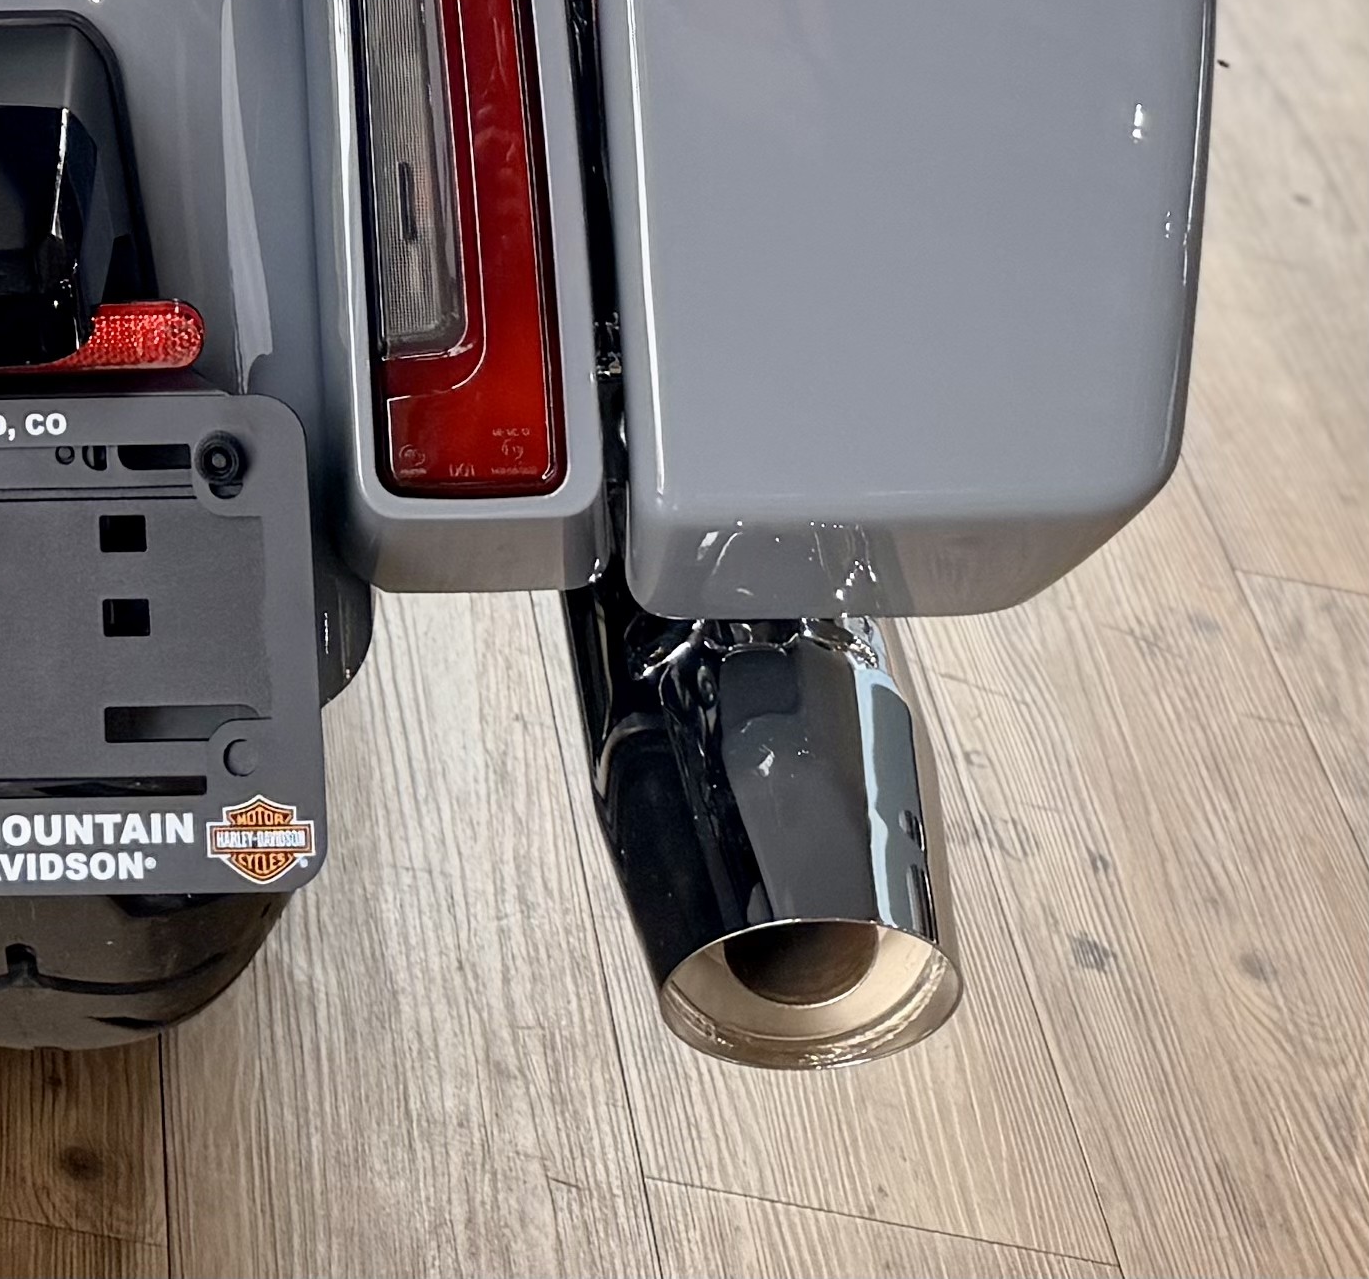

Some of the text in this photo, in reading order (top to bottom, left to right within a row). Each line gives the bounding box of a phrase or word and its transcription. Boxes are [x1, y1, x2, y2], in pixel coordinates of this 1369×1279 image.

[24, 412, 67, 436] CO
[236, 805, 284, 826] MOTOR
[237, 852, 286, 875] CYCLES
